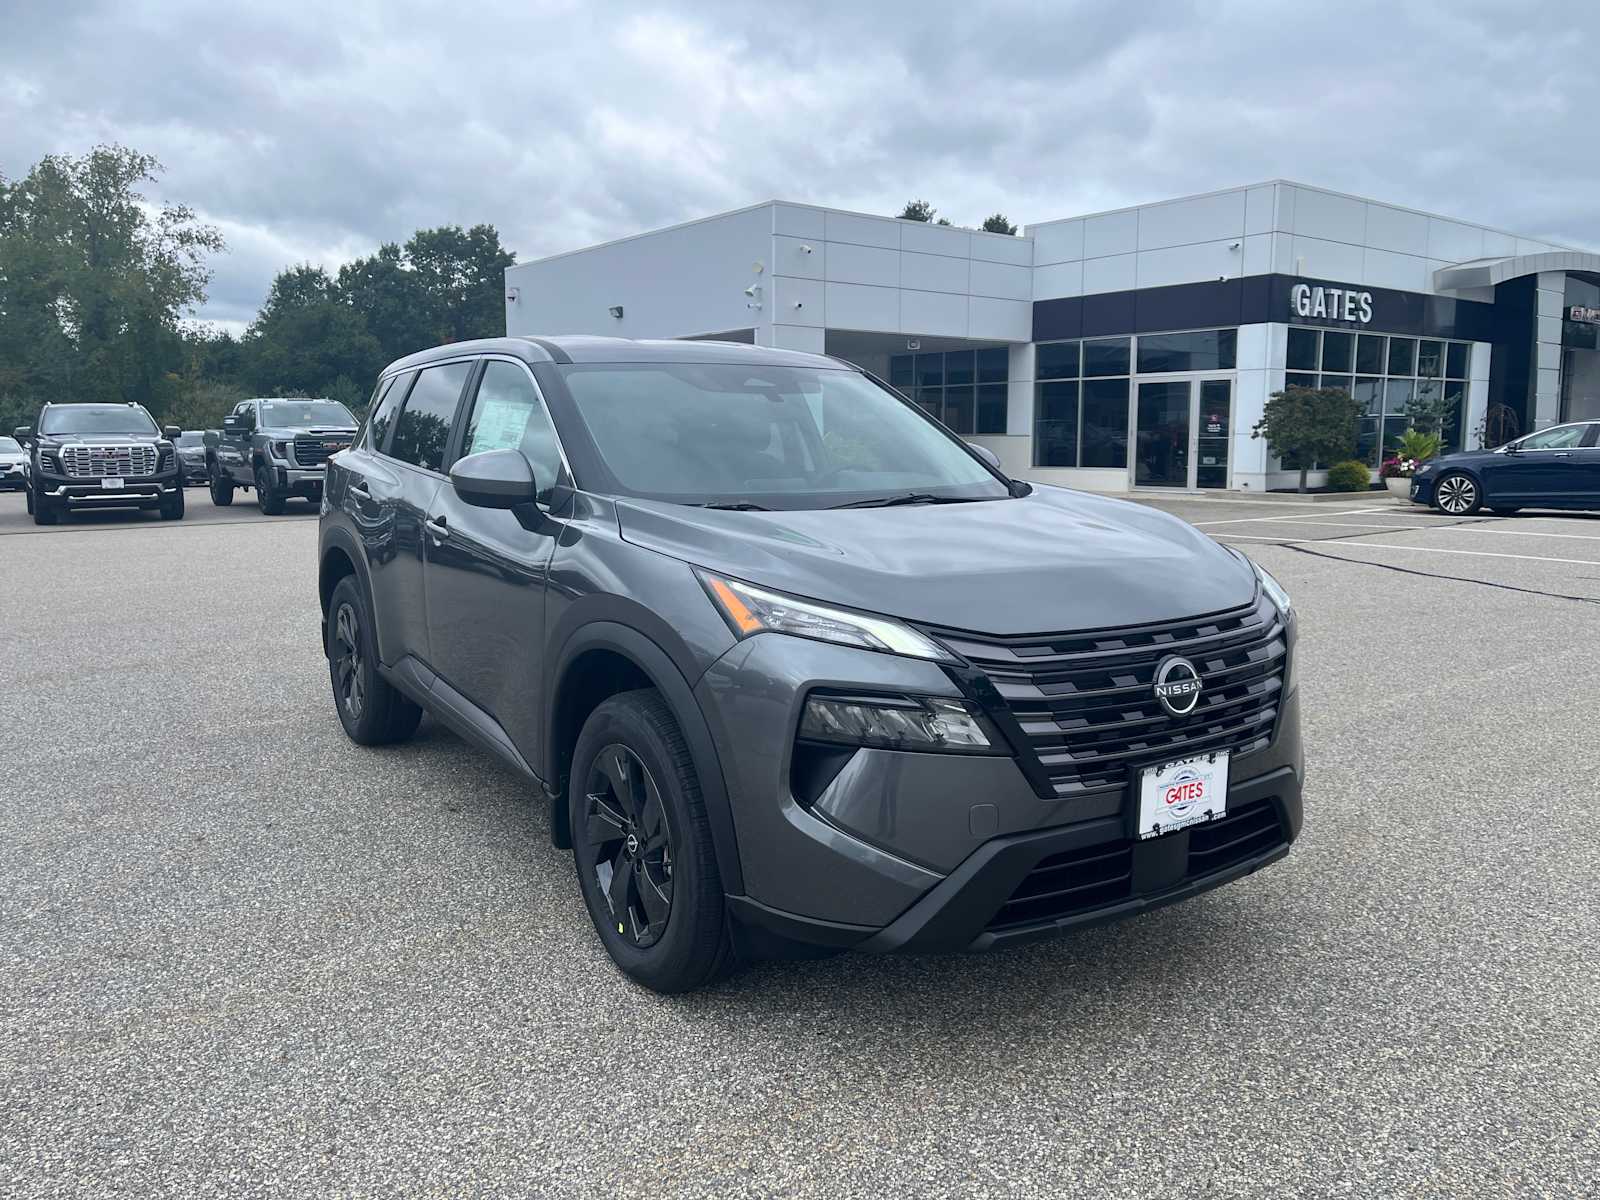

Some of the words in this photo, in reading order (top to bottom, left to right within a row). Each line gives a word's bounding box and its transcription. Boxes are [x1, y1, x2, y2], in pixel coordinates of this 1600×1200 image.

[1291, 284, 1373, 323] GATES
[1156, 681, 1203, 696] NISSAN
[1165, 782, 1204, 805] GATES
